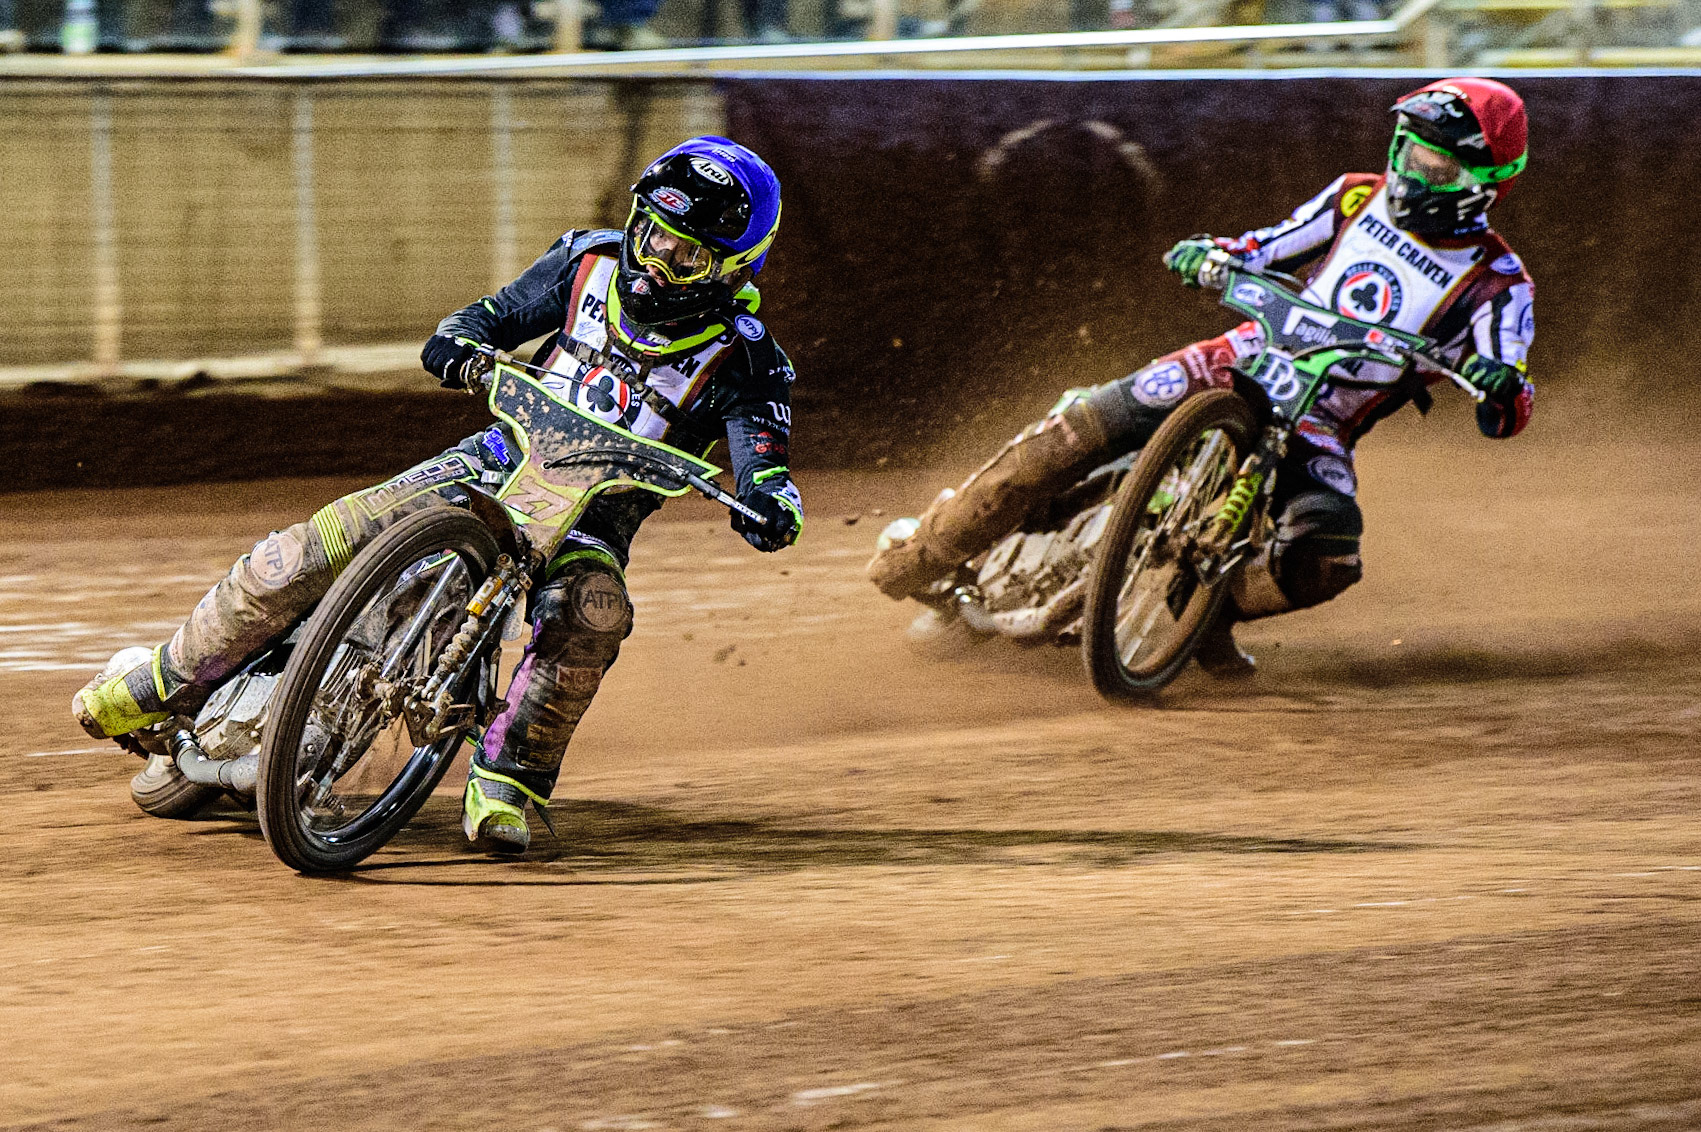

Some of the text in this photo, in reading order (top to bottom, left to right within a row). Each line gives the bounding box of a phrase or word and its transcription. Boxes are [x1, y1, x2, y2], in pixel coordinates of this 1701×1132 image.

[700, 162, 728, 182] Arai
[658, 190, 685, 209] STS
[1358, 214, 1400, 249] PETER
[1397, 242, 1453, 289] CRAVEN
